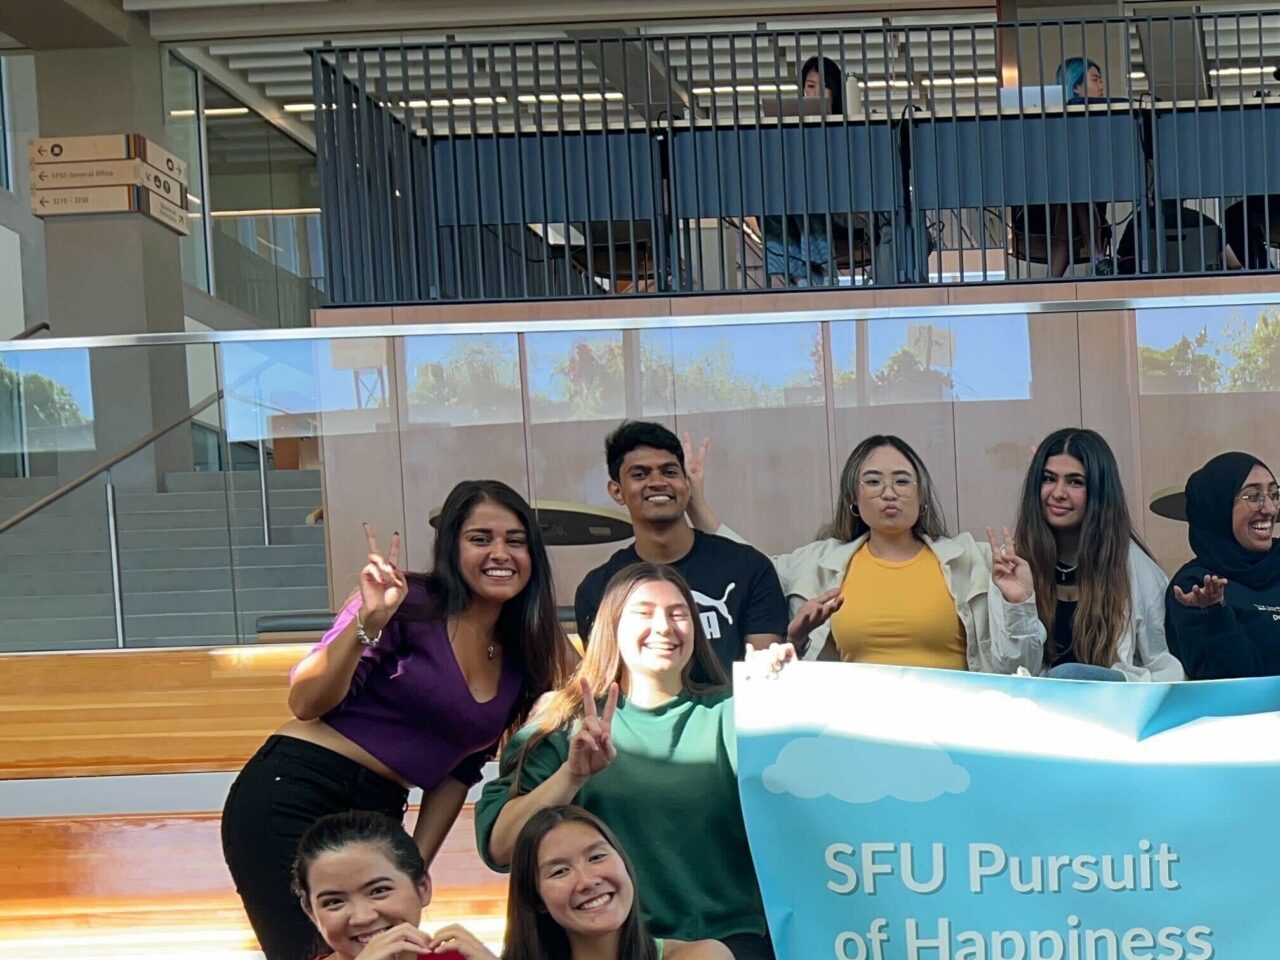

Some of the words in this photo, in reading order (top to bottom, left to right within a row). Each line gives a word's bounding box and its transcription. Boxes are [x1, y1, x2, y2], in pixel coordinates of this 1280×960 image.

[69, 170, 94, 179] General
[95, 169, 114, 177] Office
[824, 840, 947, 895] SFU
[968, 839, 1181, 895] Pursuit
